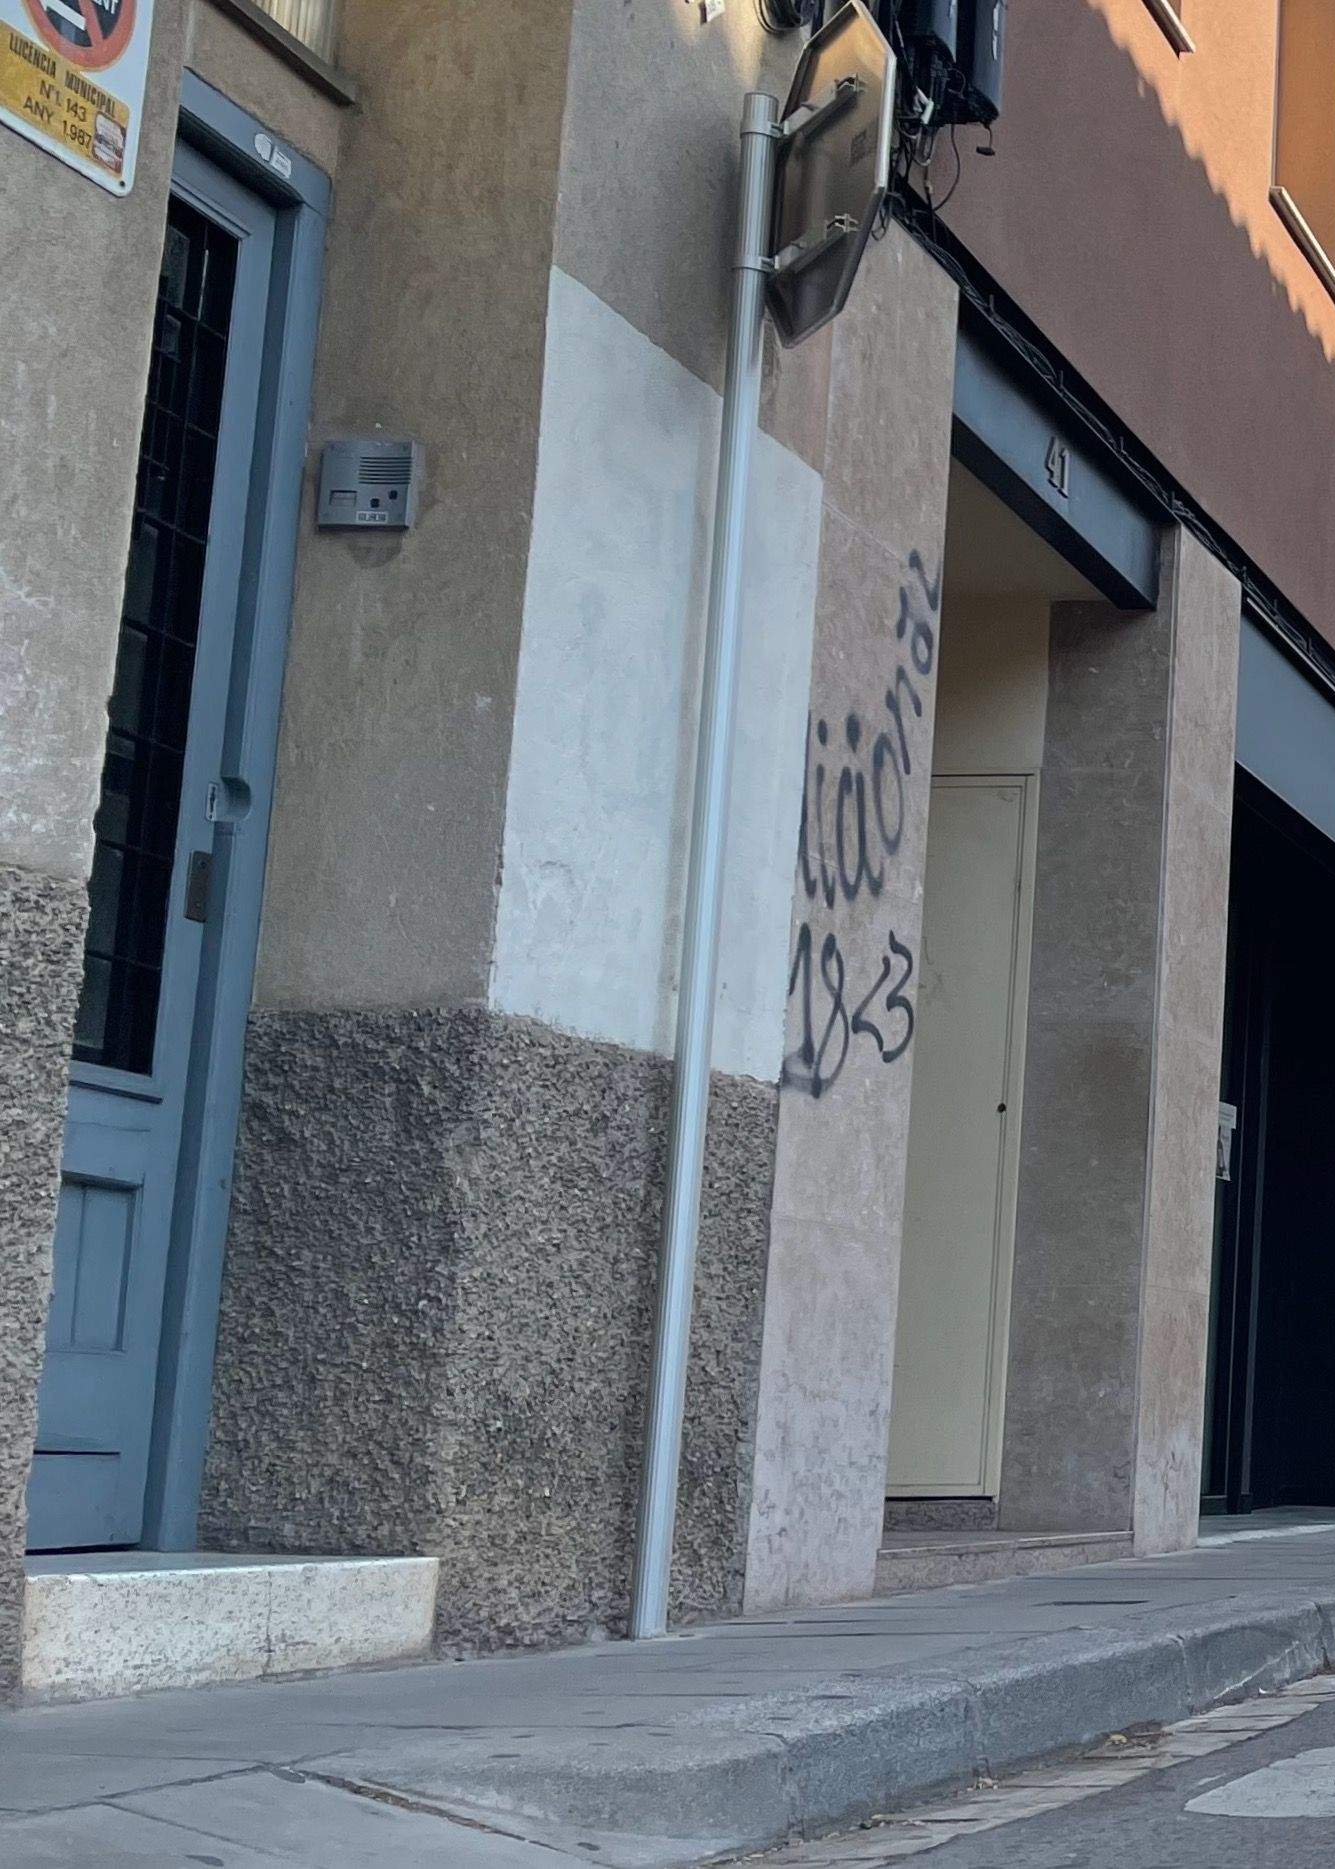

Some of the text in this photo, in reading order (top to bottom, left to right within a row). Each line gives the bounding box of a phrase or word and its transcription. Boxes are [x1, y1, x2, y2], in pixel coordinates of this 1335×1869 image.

[23, 95, 54, 124] ANY
[64, 70, 117, 119] MUNICIPAL
[1045, 437, 1070, 498] 41
